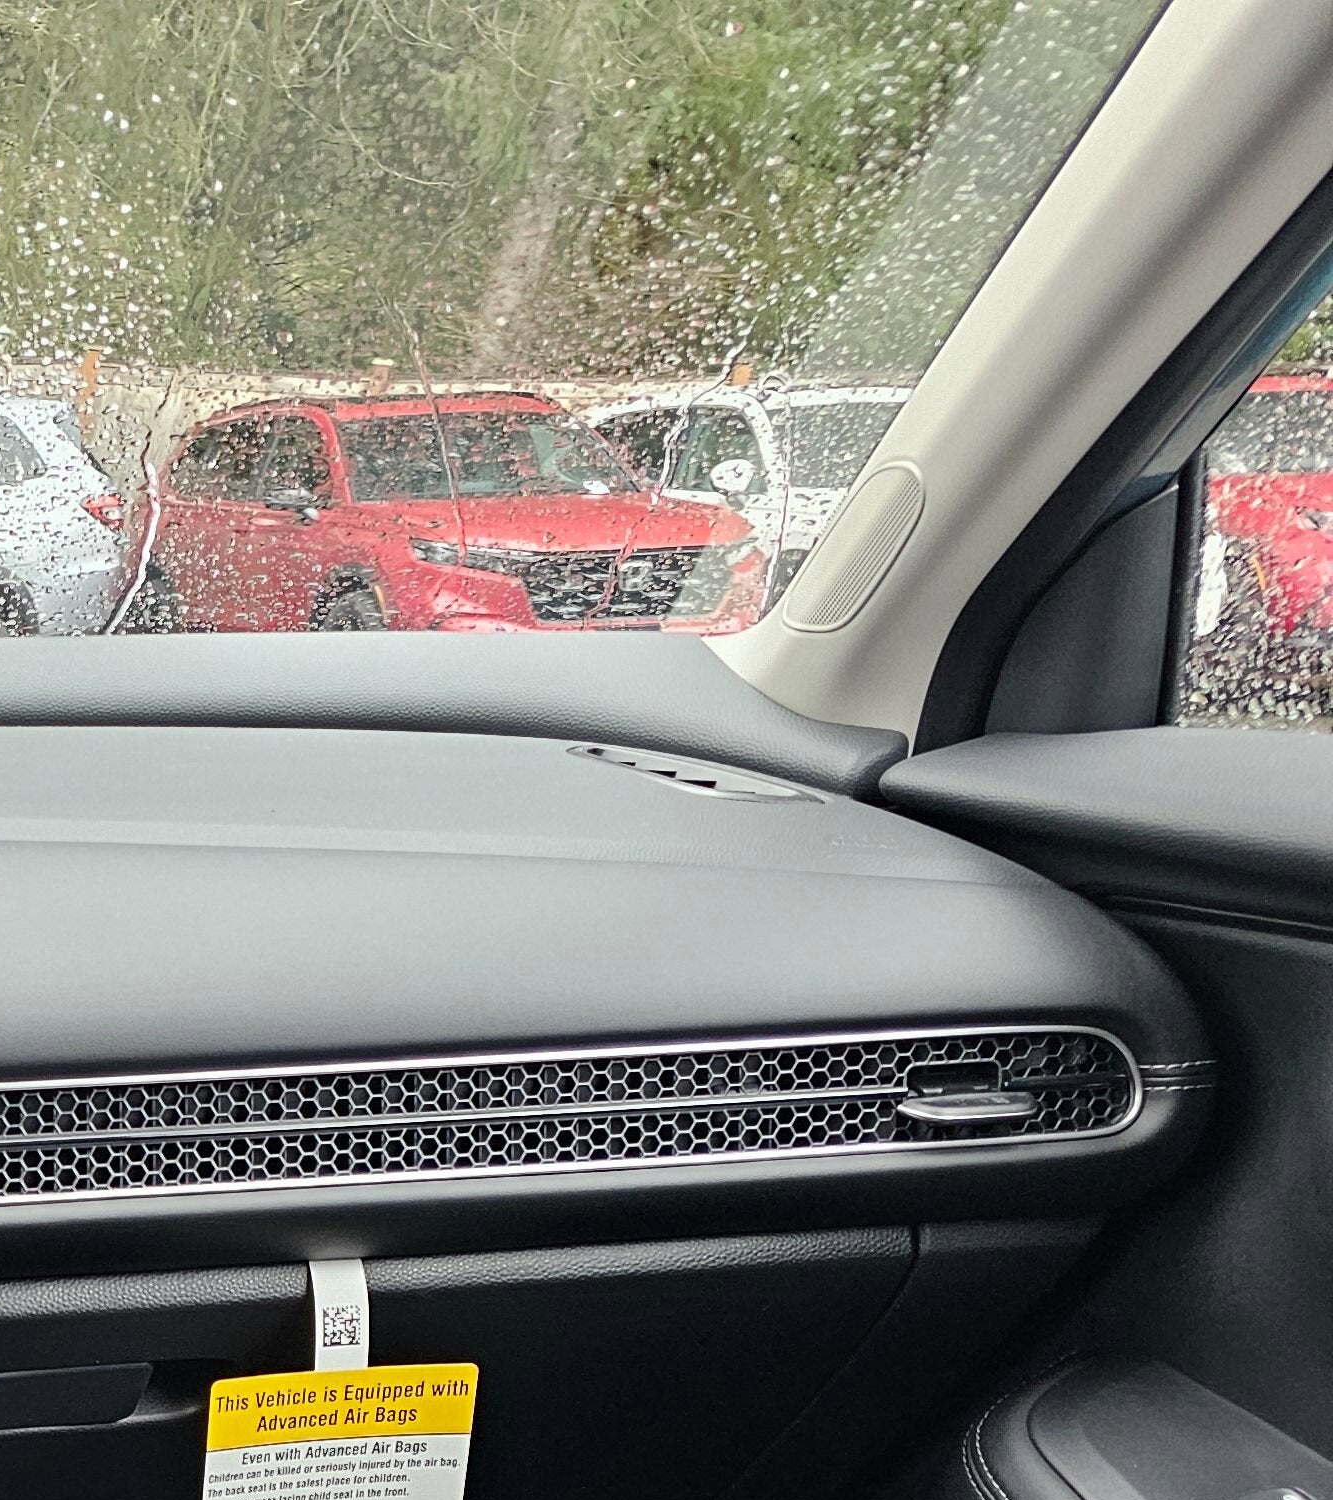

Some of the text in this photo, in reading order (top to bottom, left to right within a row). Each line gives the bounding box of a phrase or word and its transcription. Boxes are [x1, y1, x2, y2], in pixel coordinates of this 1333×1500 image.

[216, 1380, 469, 1413] This Vehicle is Equipped with
[257, 1407, 418, 1432] Advanced Air Bags
[242, 1441, 427, 1465] Even with Advanced Air Bags
[209, 1473, 244, 1484] Children
[246, 1470, 261, 1479] can
[265, 1468, 275, 1477] be
[278, 1465, 301, 1475] killed
[316, 1461, 356, 1473] seriously
[359, 1459, 391, 1473] injured
[394, 1459, 404, 1469] by
[408, 1458, 421, 1467] the
[425, 1458, 438, 1466] air
[441, 1456, 461, 1468] bag.
[208, 1474, 411, 1498] The back seat is the safest place for children.
[309, 1491, 331, 1500] child
[333, 1489, 353, 1500] seat
[356, 1489, 365, 1498] in
[368, 1489, 381, 1497] the
[385, 1488, 410, 1496] front.
